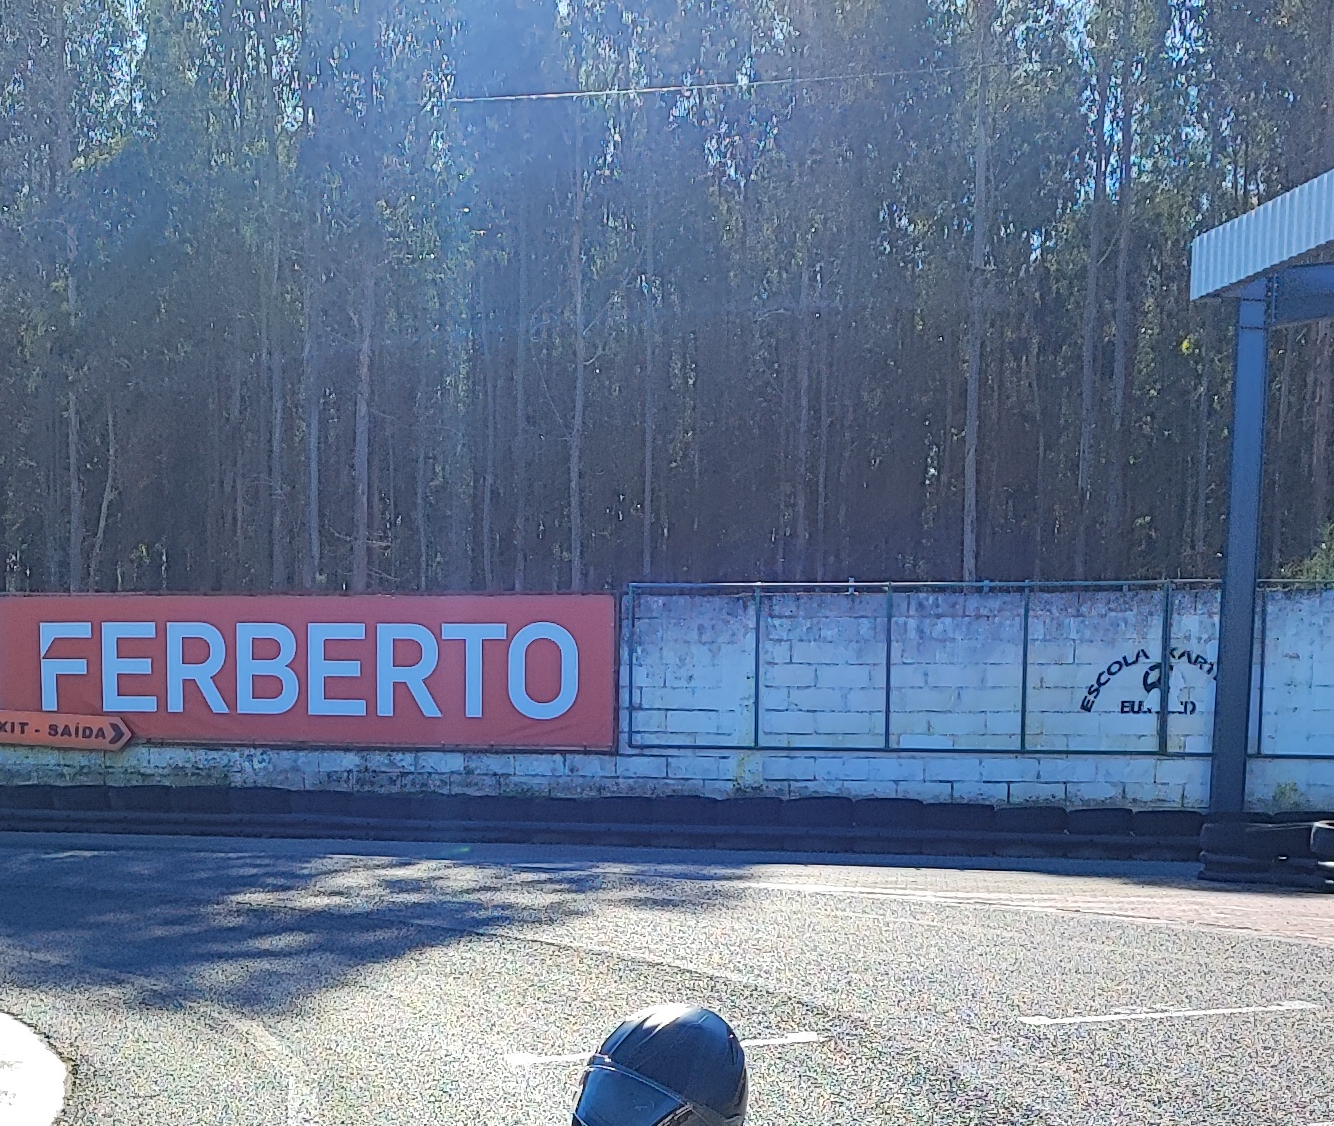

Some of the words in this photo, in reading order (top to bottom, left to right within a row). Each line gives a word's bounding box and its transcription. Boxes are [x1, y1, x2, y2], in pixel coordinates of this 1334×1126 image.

[38, 620, 580, 721] FERBERTO
[1080, 648, 1151, 713] ESCOLA
[47, 722, 107, 740] SAÍDA
